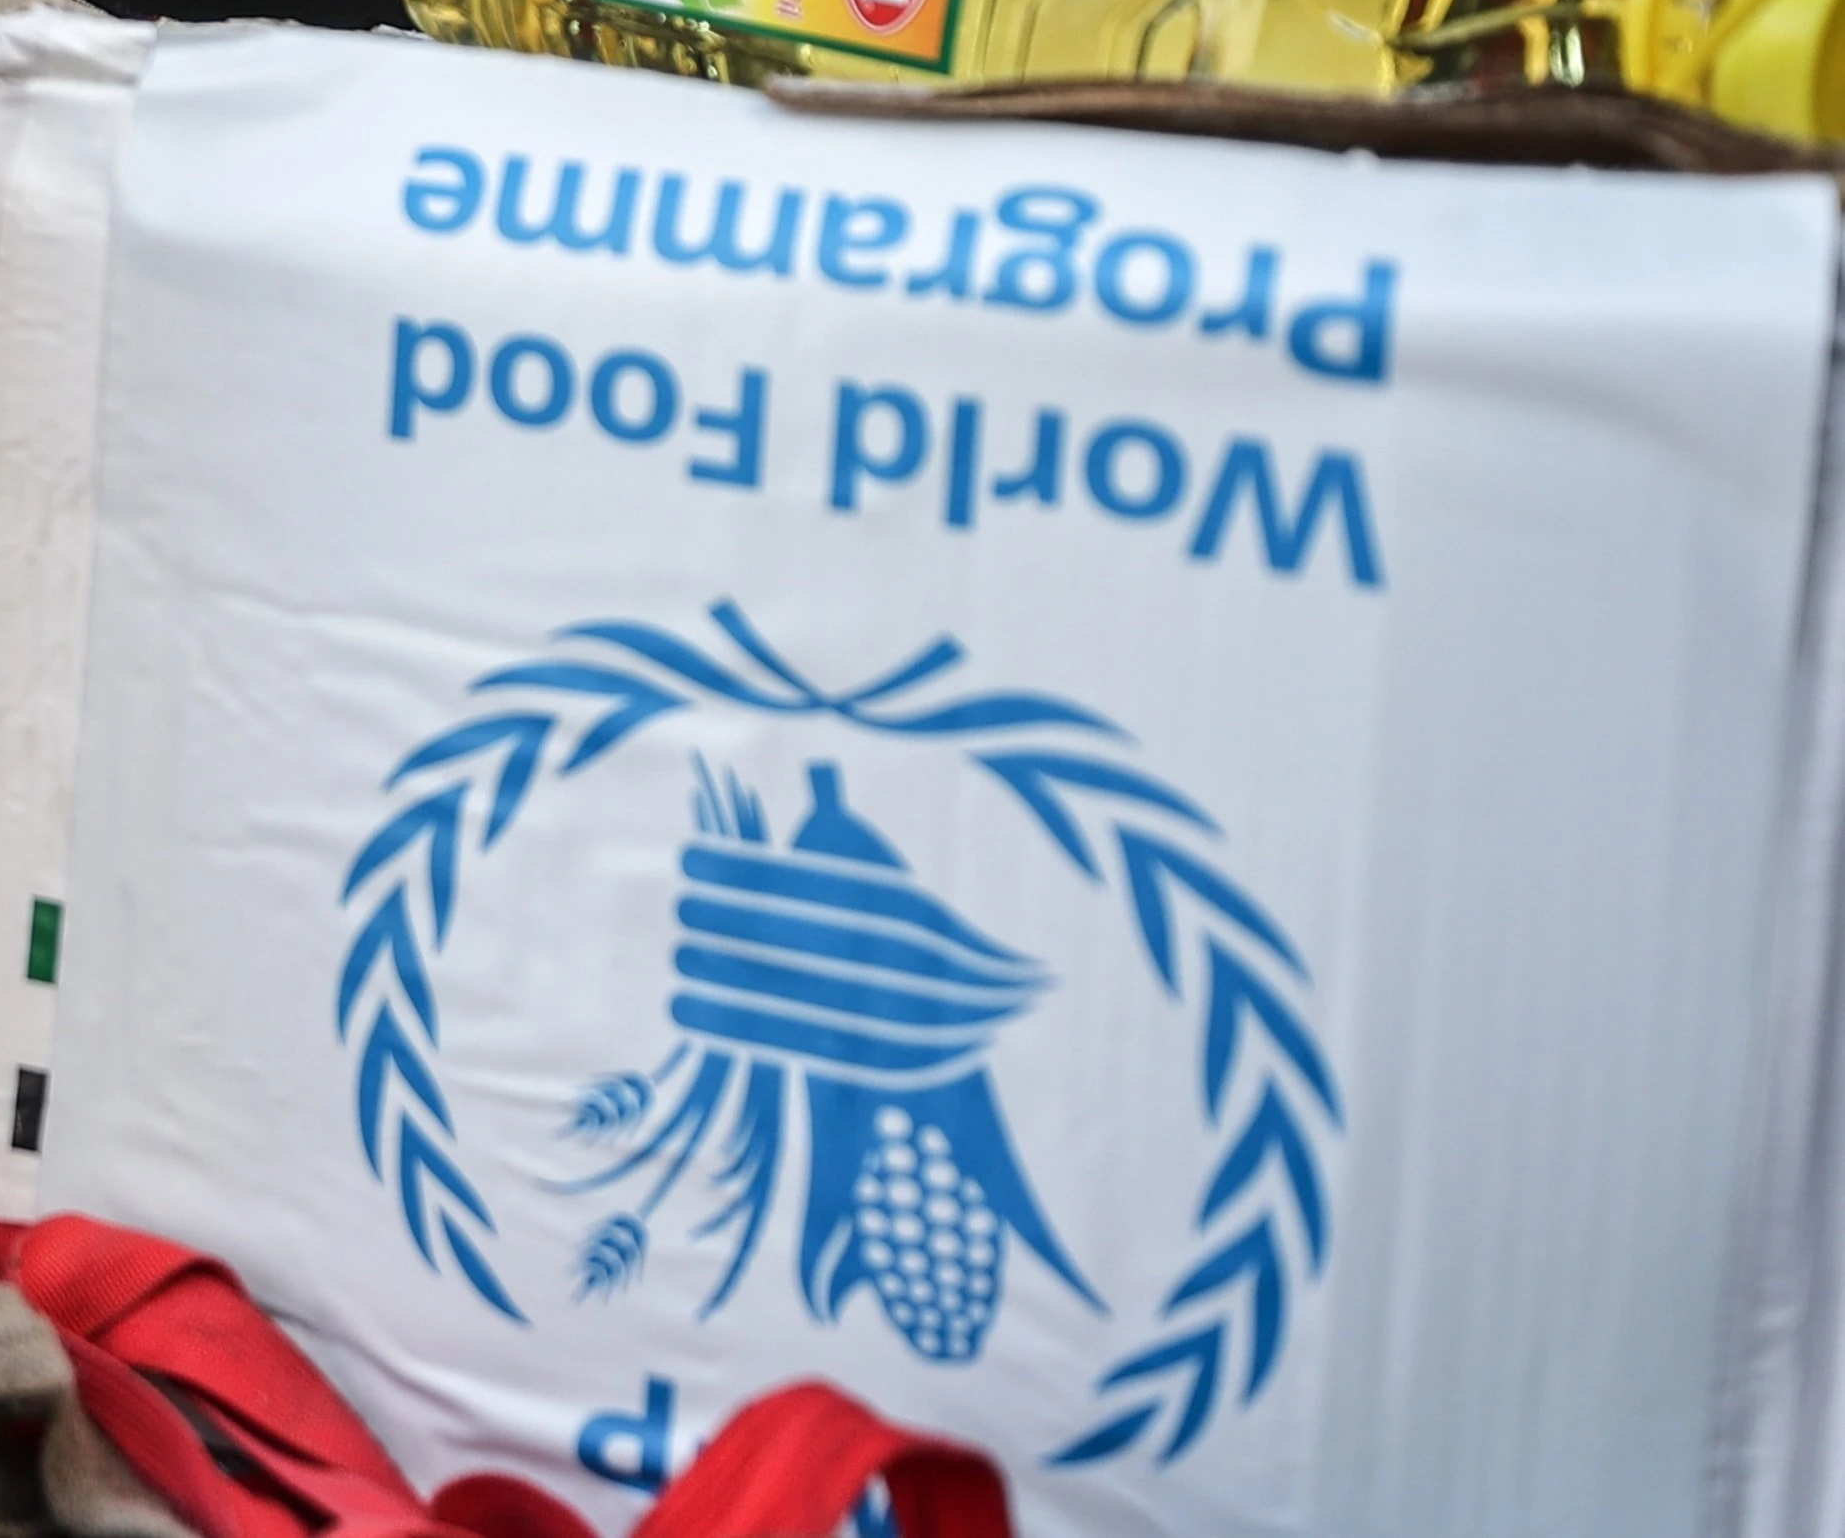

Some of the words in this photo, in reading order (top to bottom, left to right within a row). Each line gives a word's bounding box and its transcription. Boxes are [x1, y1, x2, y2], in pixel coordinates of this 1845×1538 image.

[401, 146, 1400, 386] Programme
[387, 317, 770, 491] Food
[828, 381, 1386, 590] World
